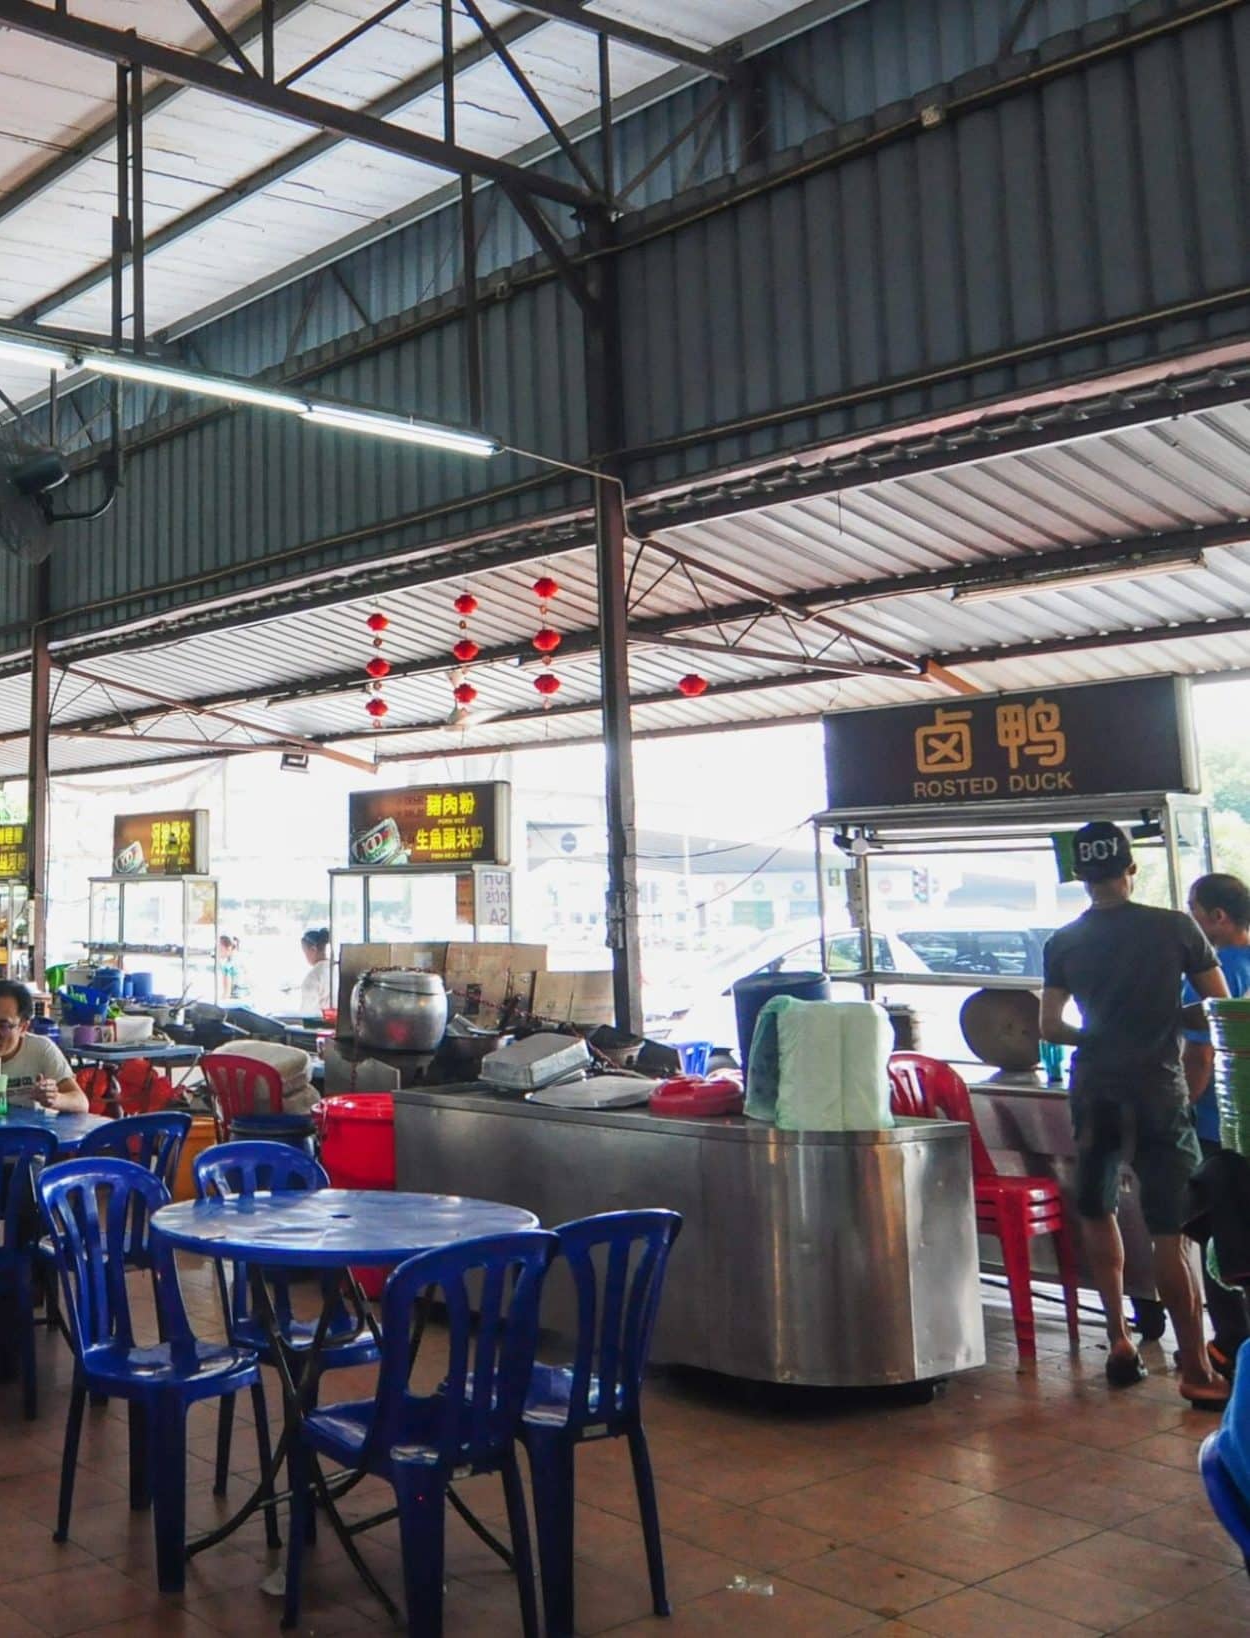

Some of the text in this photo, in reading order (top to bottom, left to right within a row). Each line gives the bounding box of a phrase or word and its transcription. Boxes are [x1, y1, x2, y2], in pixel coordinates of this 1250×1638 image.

[913, 771, 1073, 798] ROSTED DUCK
[427, 791, 475, 816] 豬肉粉
[1079, 837, 1118, 862] BOY
